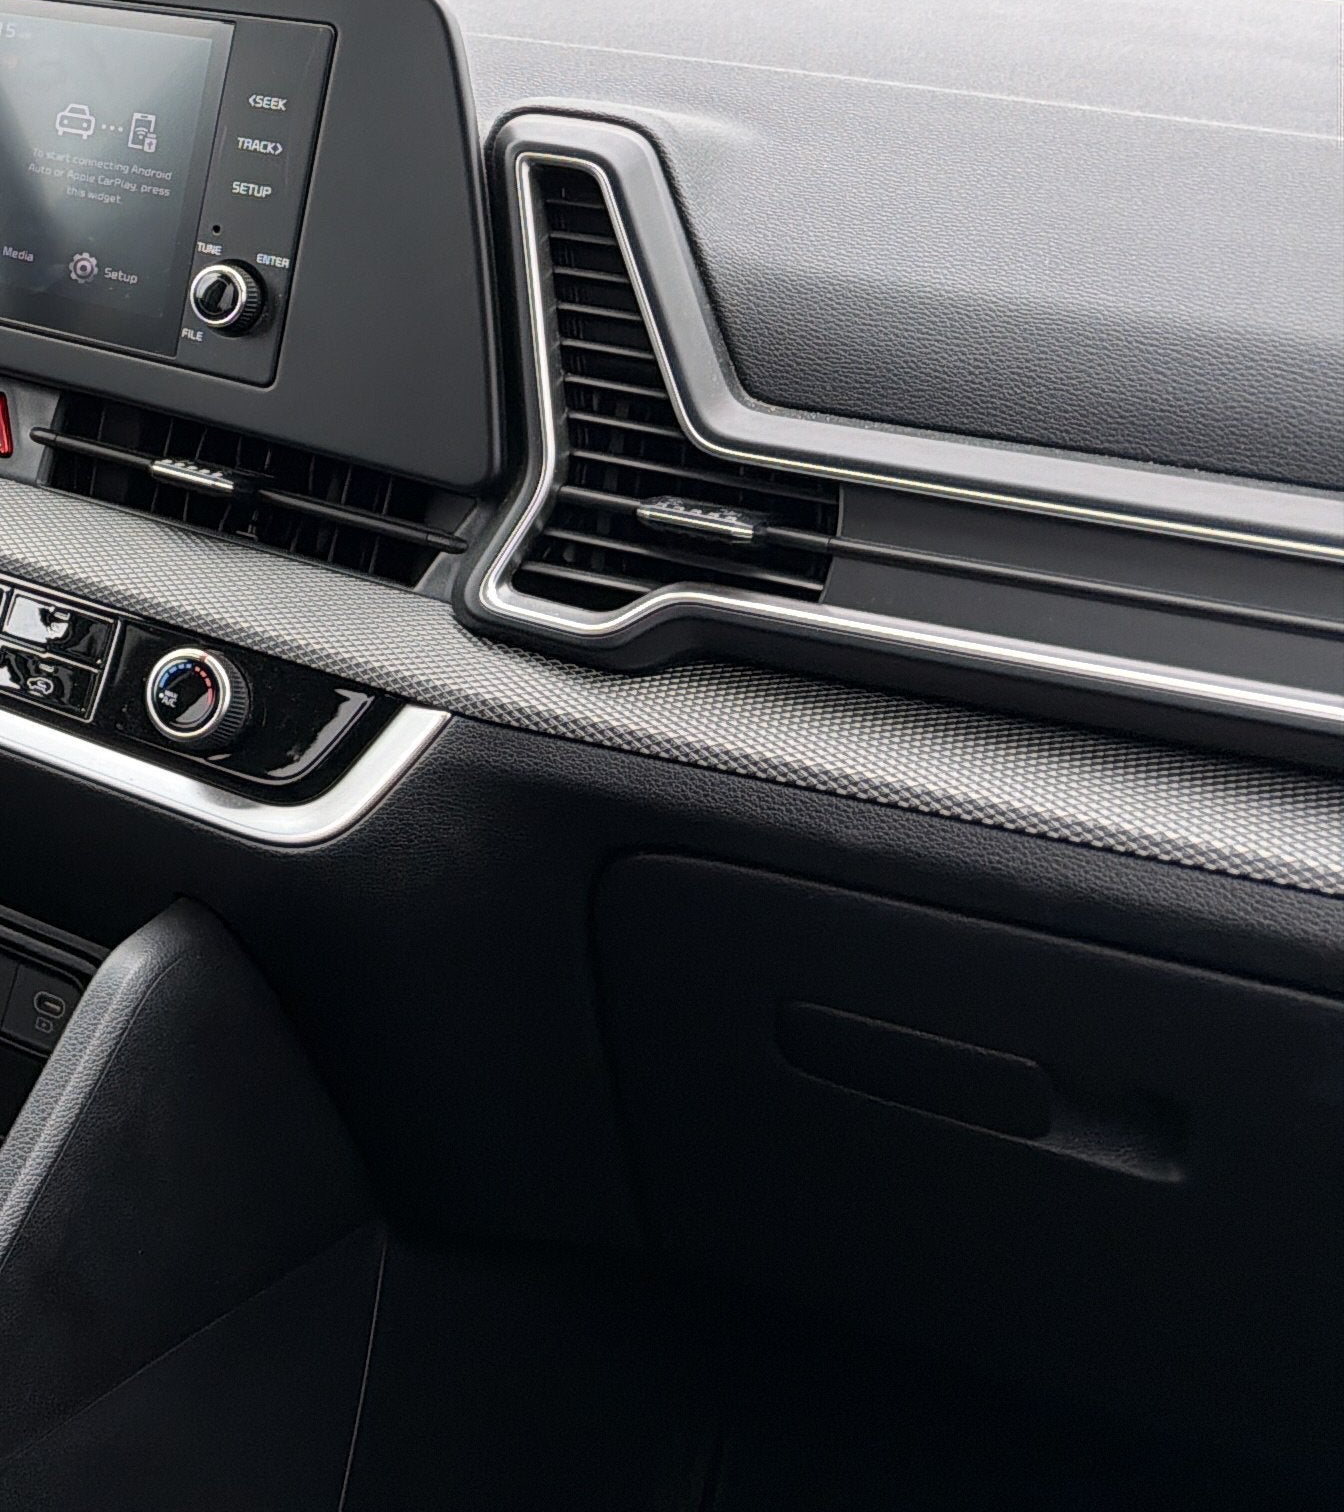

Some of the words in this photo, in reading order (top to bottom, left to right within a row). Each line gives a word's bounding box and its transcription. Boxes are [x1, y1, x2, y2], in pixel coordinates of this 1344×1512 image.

[33, 147, 45, 159] To
[46, 150, 71, 164] start
[72, 155, 130, 175] connecting
[131, 164, 173, 181] Android
[28, 163, 52, 176] Auto
[54, 168, 65, 178] or
[66, 169, 97, 185] Apple
[140, 184, 172, 198] press
[65, 186, 87, 199] this
[232, 181, 272, 198] SETUP
[3, 246, 34, 263] Media
[197, 241, 223, 256] TUNE
[256, 253, 290, 269] ENTER
[104, 267, 139, 285] Setup
[181, 328, 204, 341] FILE
